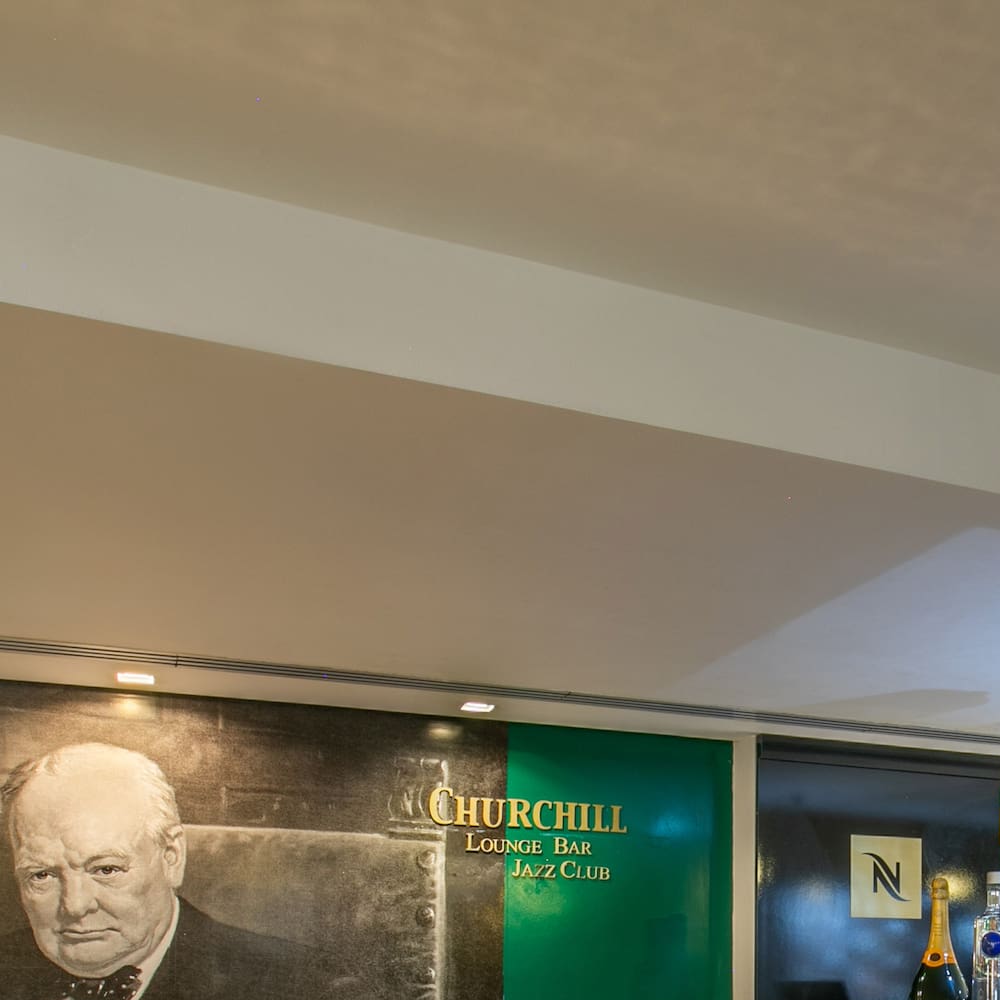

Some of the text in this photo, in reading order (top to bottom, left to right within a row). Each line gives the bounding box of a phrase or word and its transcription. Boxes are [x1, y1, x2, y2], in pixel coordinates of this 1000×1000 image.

[429, 787, 627, 834] CHURCHILL
[465, 833, 592, 856] LOUNGE BAR
[512, 859, 610, 881] JAZZ CLUB
